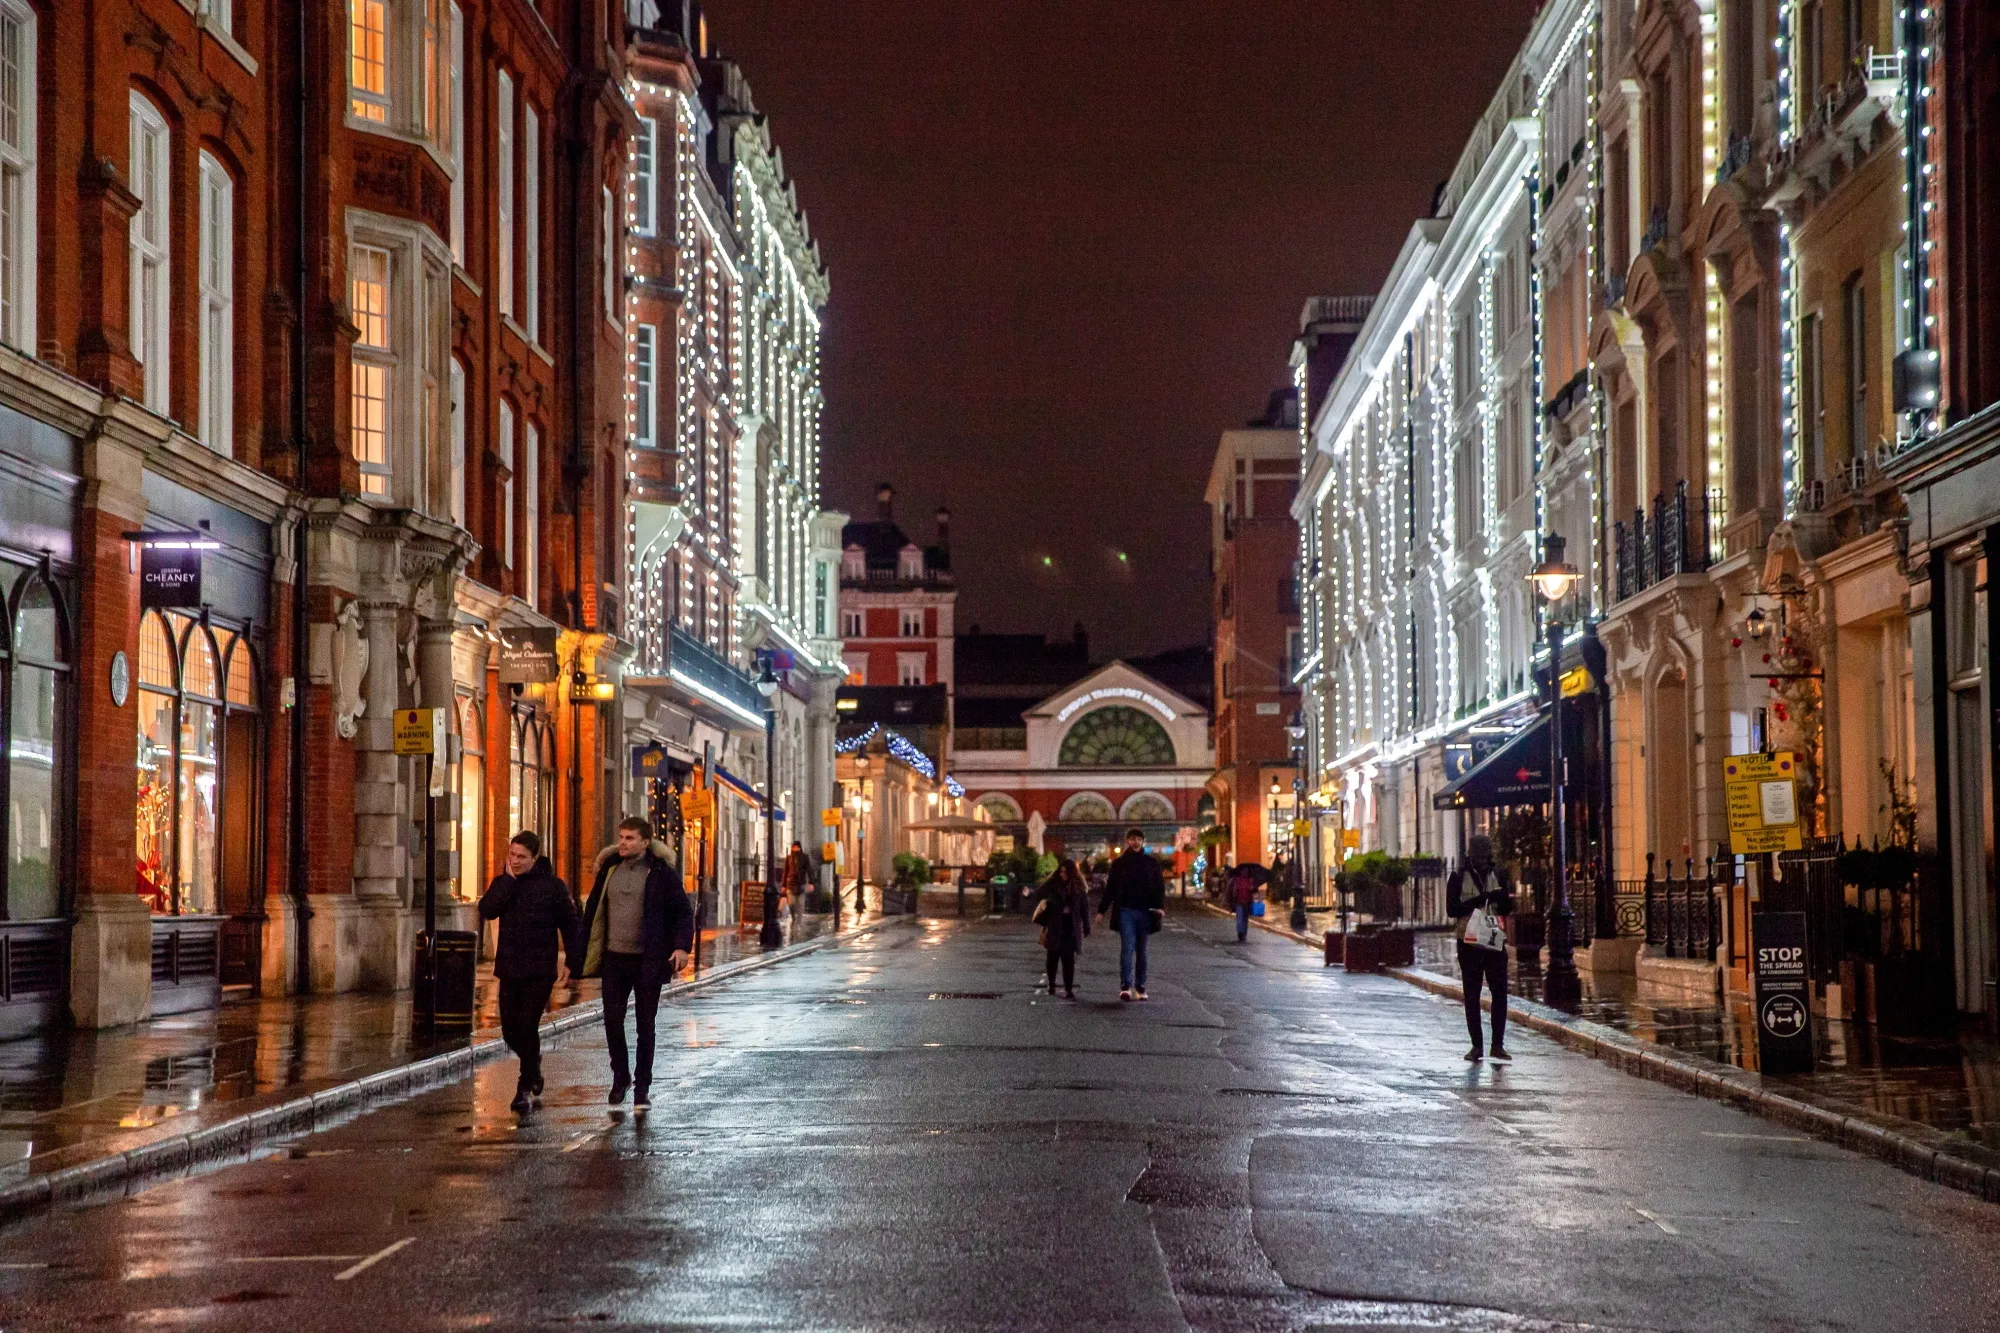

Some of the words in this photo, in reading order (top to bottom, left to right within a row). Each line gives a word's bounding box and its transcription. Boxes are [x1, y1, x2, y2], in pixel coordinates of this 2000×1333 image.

[145, 573, 195, 582] CHEANEY
[1091, 687, 1143, 700] TRANSPORT
[397, 731, 430, 739] WARNING
[1741, 771, 1779, 780] Suspended
[1759, 835, 1786, 843] waiting
[1759, 947, 1802, 961] STOP
[1760, 962, 1774, 970] THE
[1775, 961, 1804, 969] SPREAD
